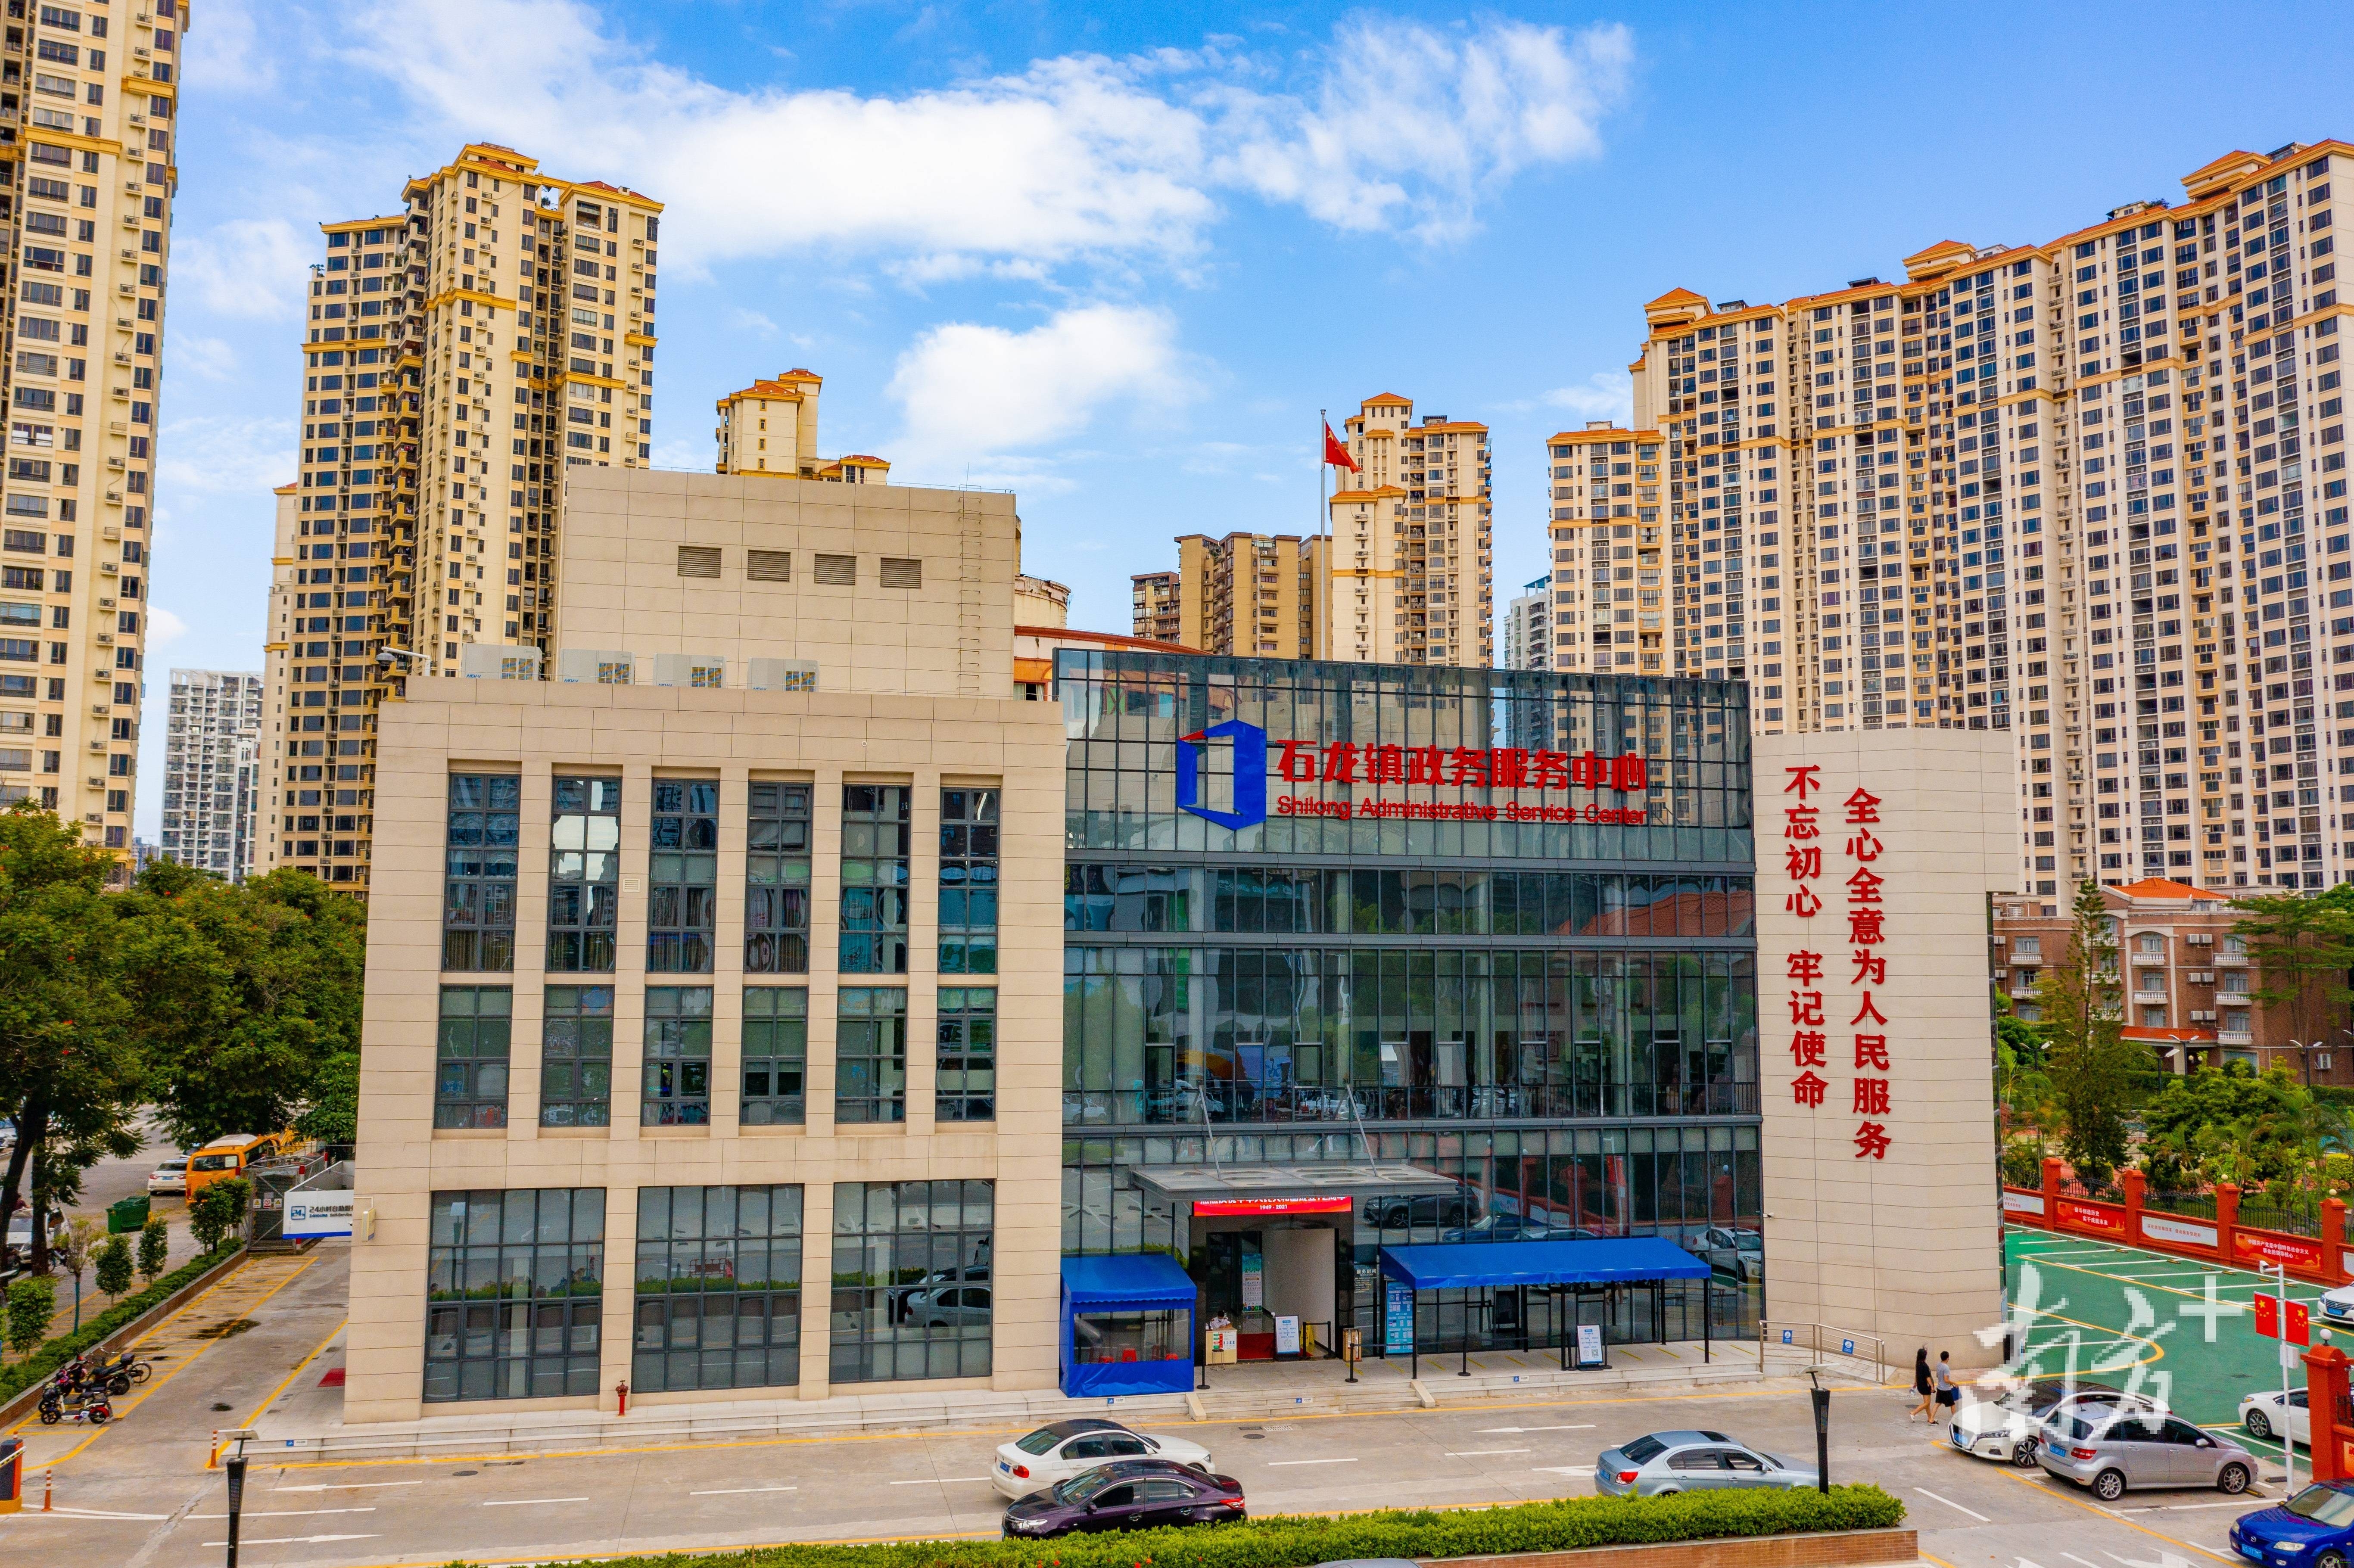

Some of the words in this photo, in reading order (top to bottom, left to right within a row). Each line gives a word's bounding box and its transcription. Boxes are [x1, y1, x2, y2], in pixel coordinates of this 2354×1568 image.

[1277, 739, 1647, 791] 石龙镇政务服务中心
[1277, 795, 1351, 820] Shilong
[1359, 797, 1498, 820] Administrative
[1506, 801, 1577, 822] Service
[1584, 803, 1647, 824] Center
[1784, 765, 1822, 917] 不忘初心
[1843, 787, 1891, 1160] 全心全意为人民服务
[1787, 949, 1828, 1108] 牢记使命
[2074, 1207, 2099, 1217] 奋斗创造历史
[2082, 1216, 2108, 1226] 实干成就未来
[2248, 1239, 2309, 1254] 中国共产党是中国特色社会主义
